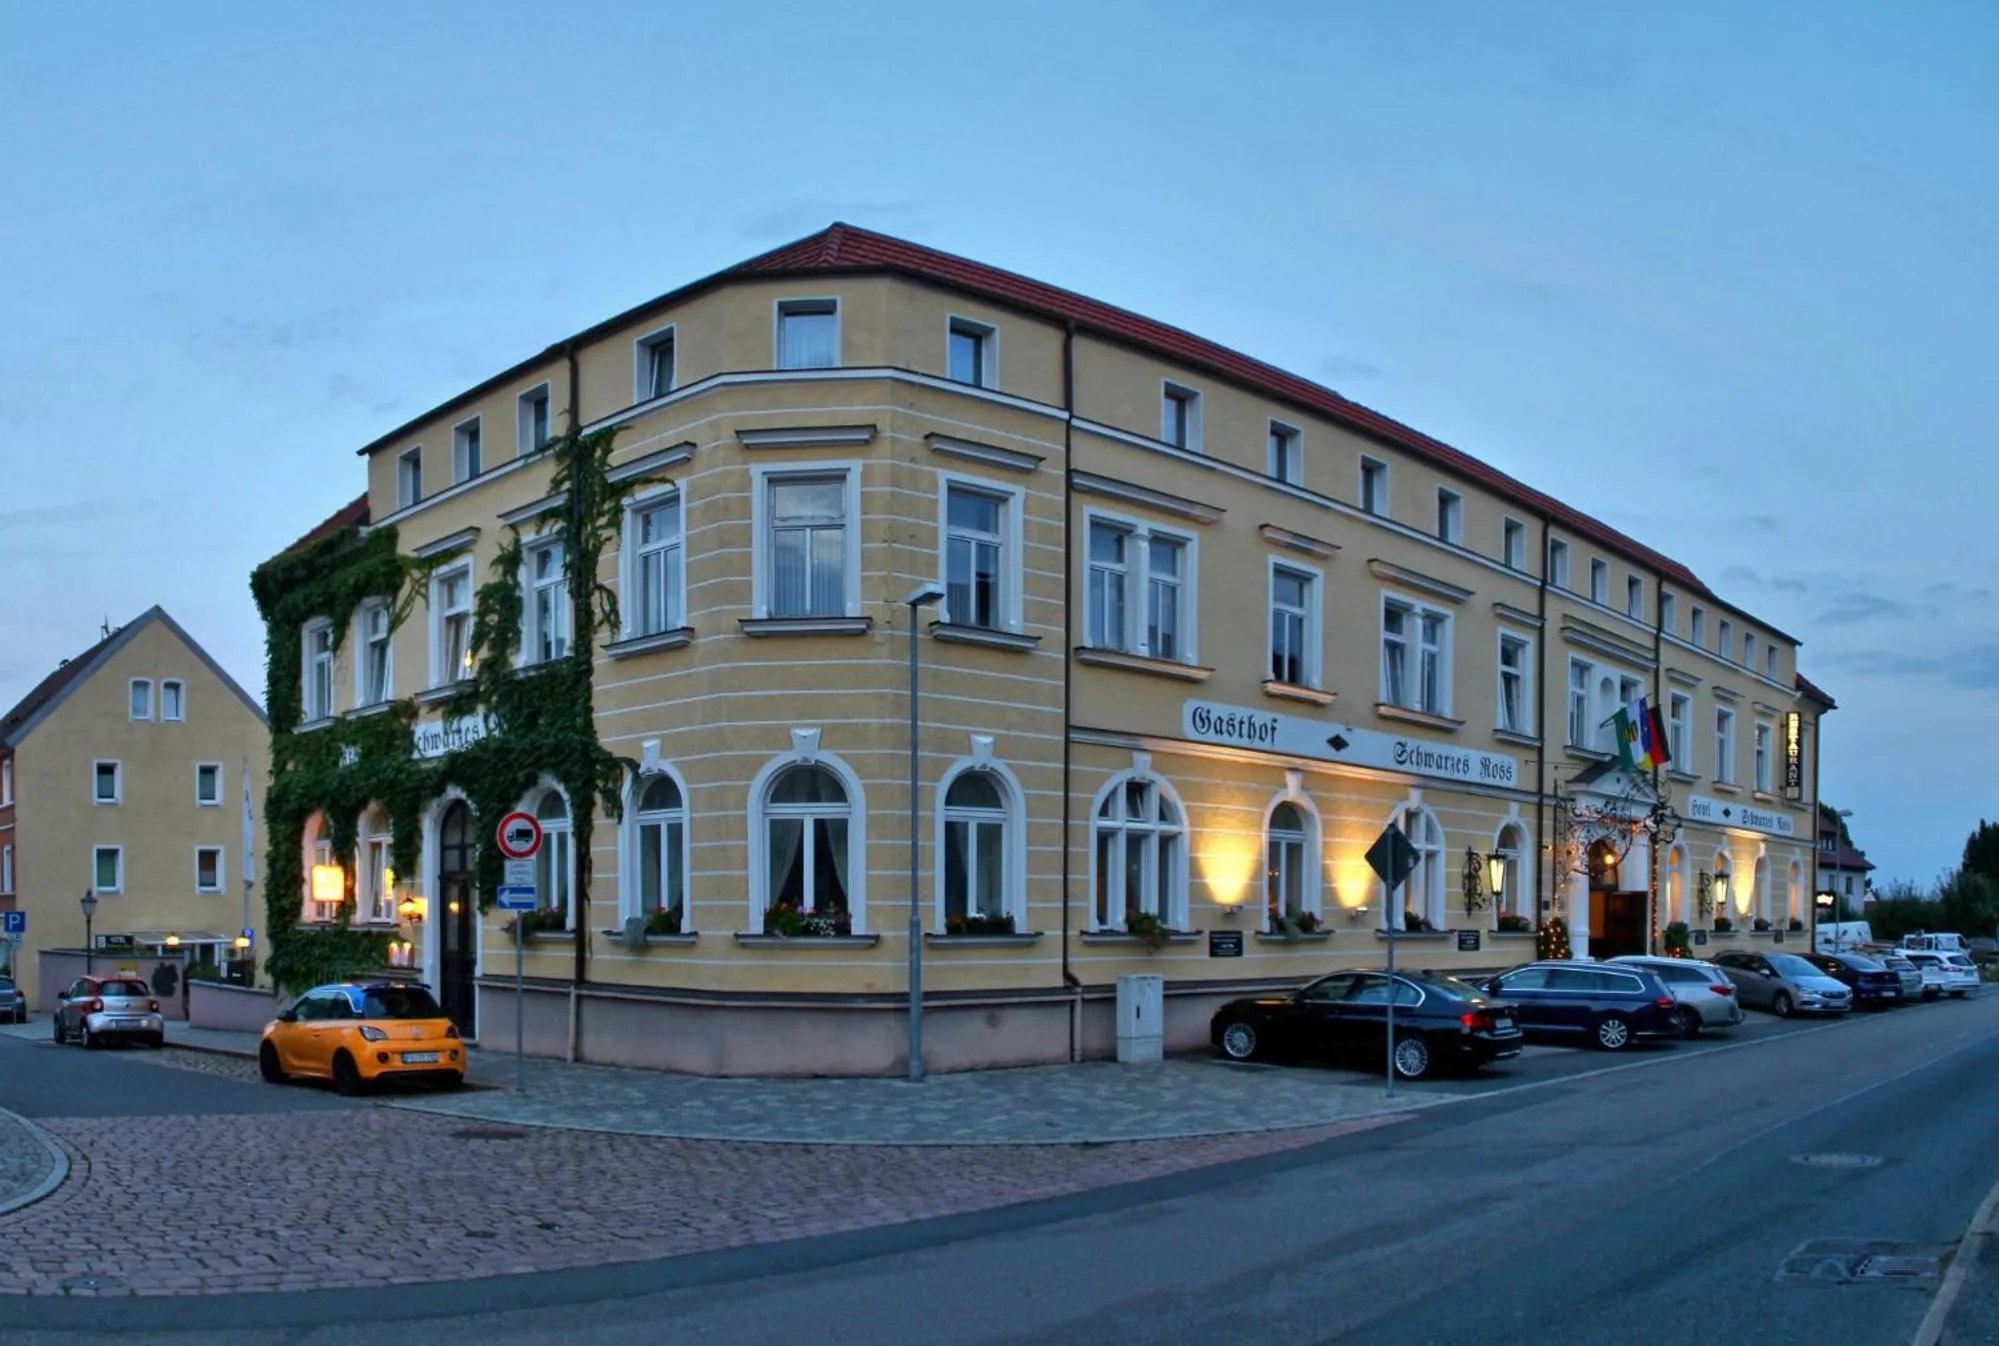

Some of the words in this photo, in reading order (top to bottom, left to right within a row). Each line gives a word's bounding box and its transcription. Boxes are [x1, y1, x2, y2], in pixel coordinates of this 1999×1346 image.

[1192, 706, 1278, 746] Gasthof
[1393, 739, 1470, 776] Schwarzes
[1480, 756, 1513, 781] Ross
[9, 914, 20, 929] P
